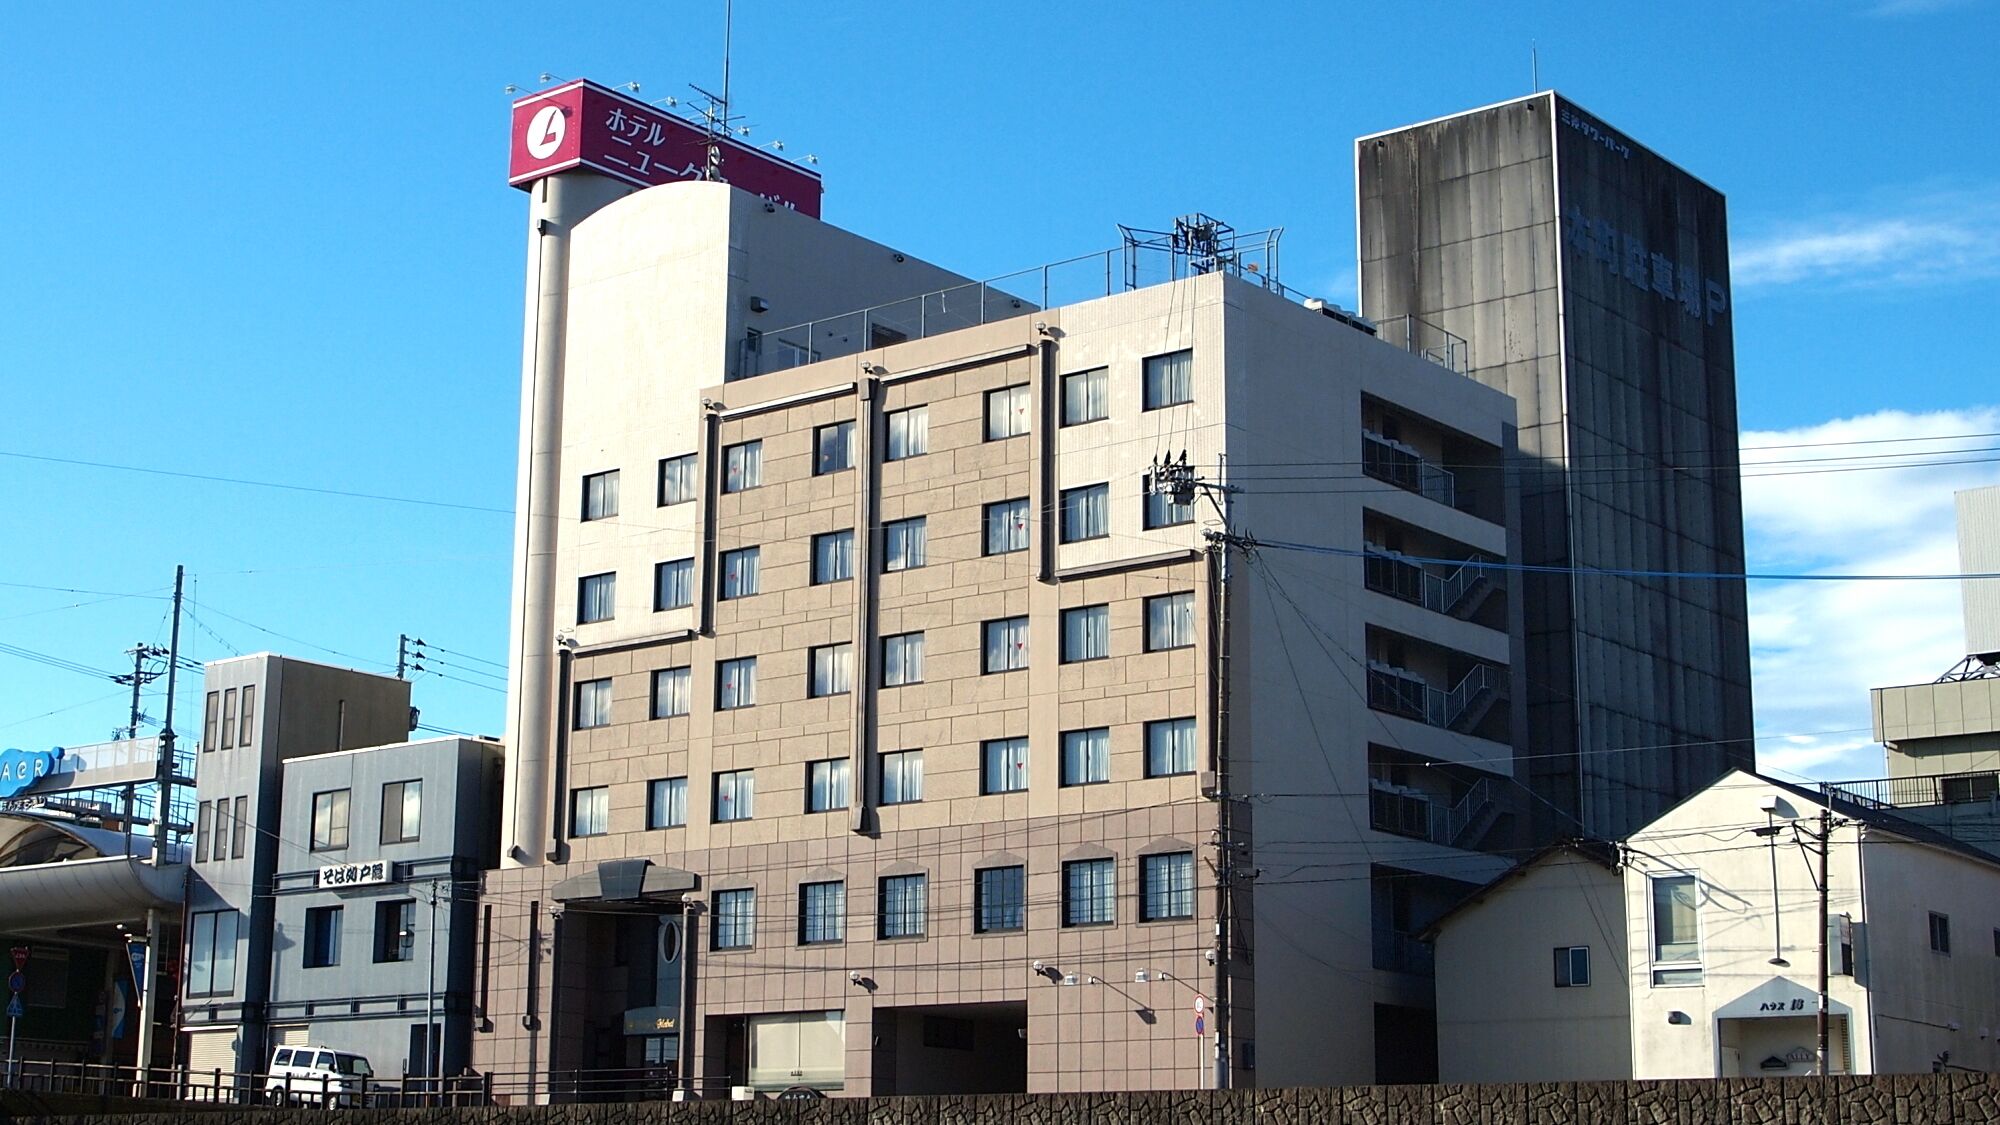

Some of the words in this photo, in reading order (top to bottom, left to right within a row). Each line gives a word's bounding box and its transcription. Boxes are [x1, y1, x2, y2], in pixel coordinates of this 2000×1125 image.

[605, 108, 665, 146] ホテル
[1760, 1002, 1785, 1011] ハウス
